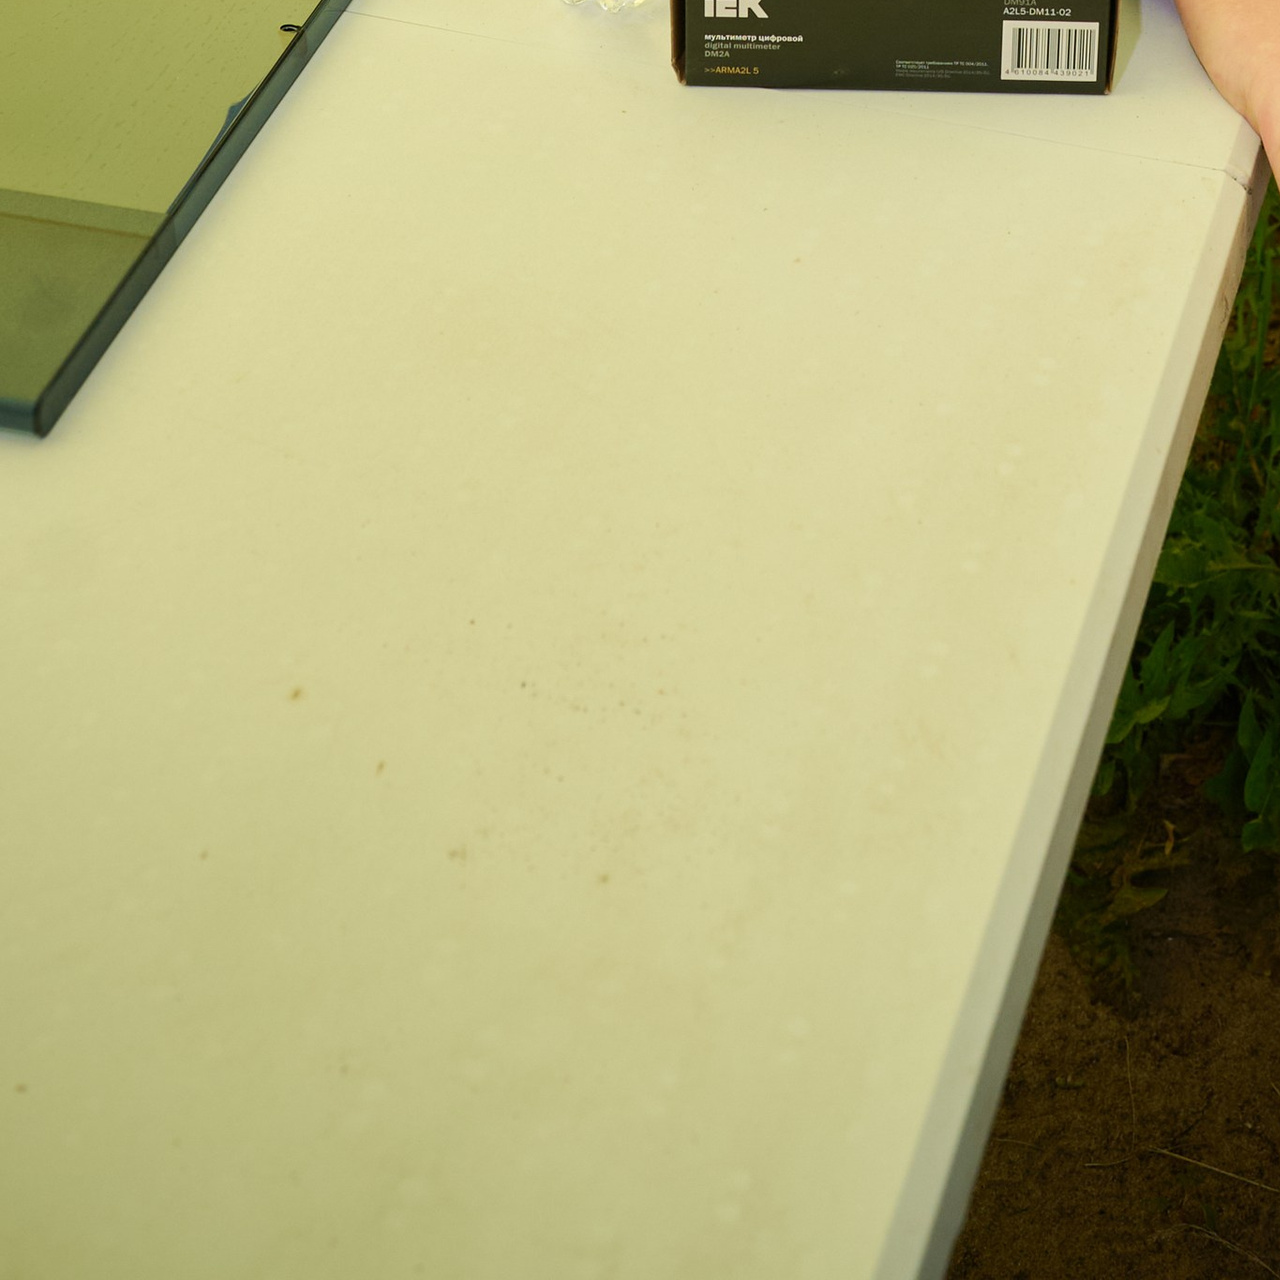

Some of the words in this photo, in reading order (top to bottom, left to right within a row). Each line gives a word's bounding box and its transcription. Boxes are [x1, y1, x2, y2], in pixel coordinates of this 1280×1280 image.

[704, 34, 757, 43] мультиметр
[758, 34, 803, 43] цифровой
[704, 42, 732, 50] digital
[733, 42, 781, 50] multimeter
[704, 50, 730, 58] DM2A
[753, 67, 759, 75] 5
